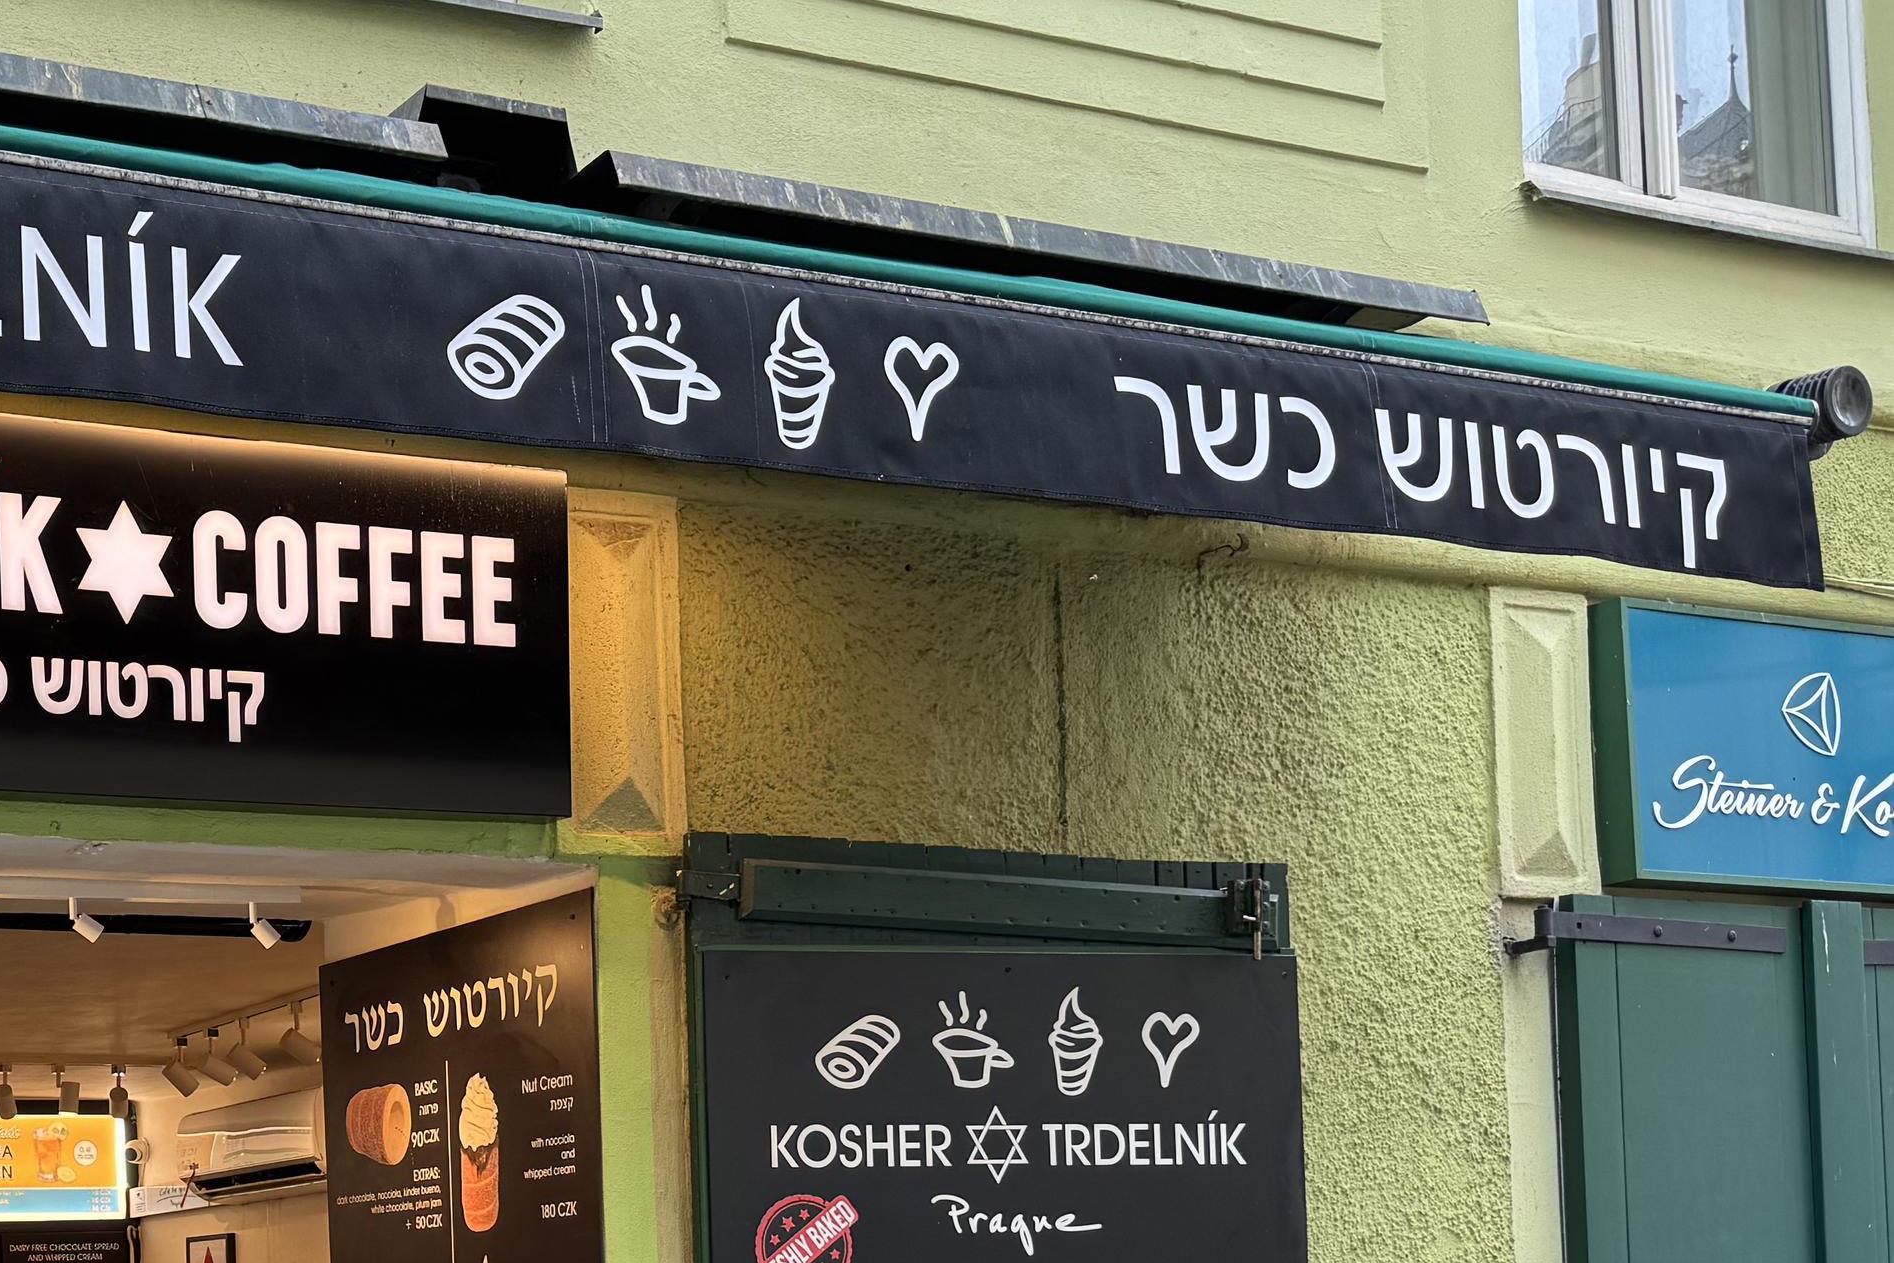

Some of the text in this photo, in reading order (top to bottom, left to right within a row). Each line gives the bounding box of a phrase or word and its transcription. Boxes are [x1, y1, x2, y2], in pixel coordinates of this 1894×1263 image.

[1114, 375, 1728, 569] קיורטוש כשר
[191, 510, 518, 647] COFFEE
[31, 655, 264, 743] קיורטוש
[1653, 755, 1804, 831] Steiner
[1811, 777, 1840, 825] &
[345, 964, 557, 1053] קיורטוש כשר
[414, 1080, 438, 1097] BASIC
[521, 1073, 573, 1094] Nut Cream
[550, 1097, 573, 1112] קצפת
[411, 1128, 440, 1149] 90 CZK
[531, 1133, 575, 1150] with nocciola
[770, 1109, 1247, 1168] KOSHER TRDELNÍK
[561, 1148, 575, 1160] and
[413, 1167, 441, 1181] EXTRAS:
[524, 1164, 576, 1180] whipped cream
[541, 1200, 577, 1219] 180 CZK
[806, 1200, 855, 1249] BAKED
